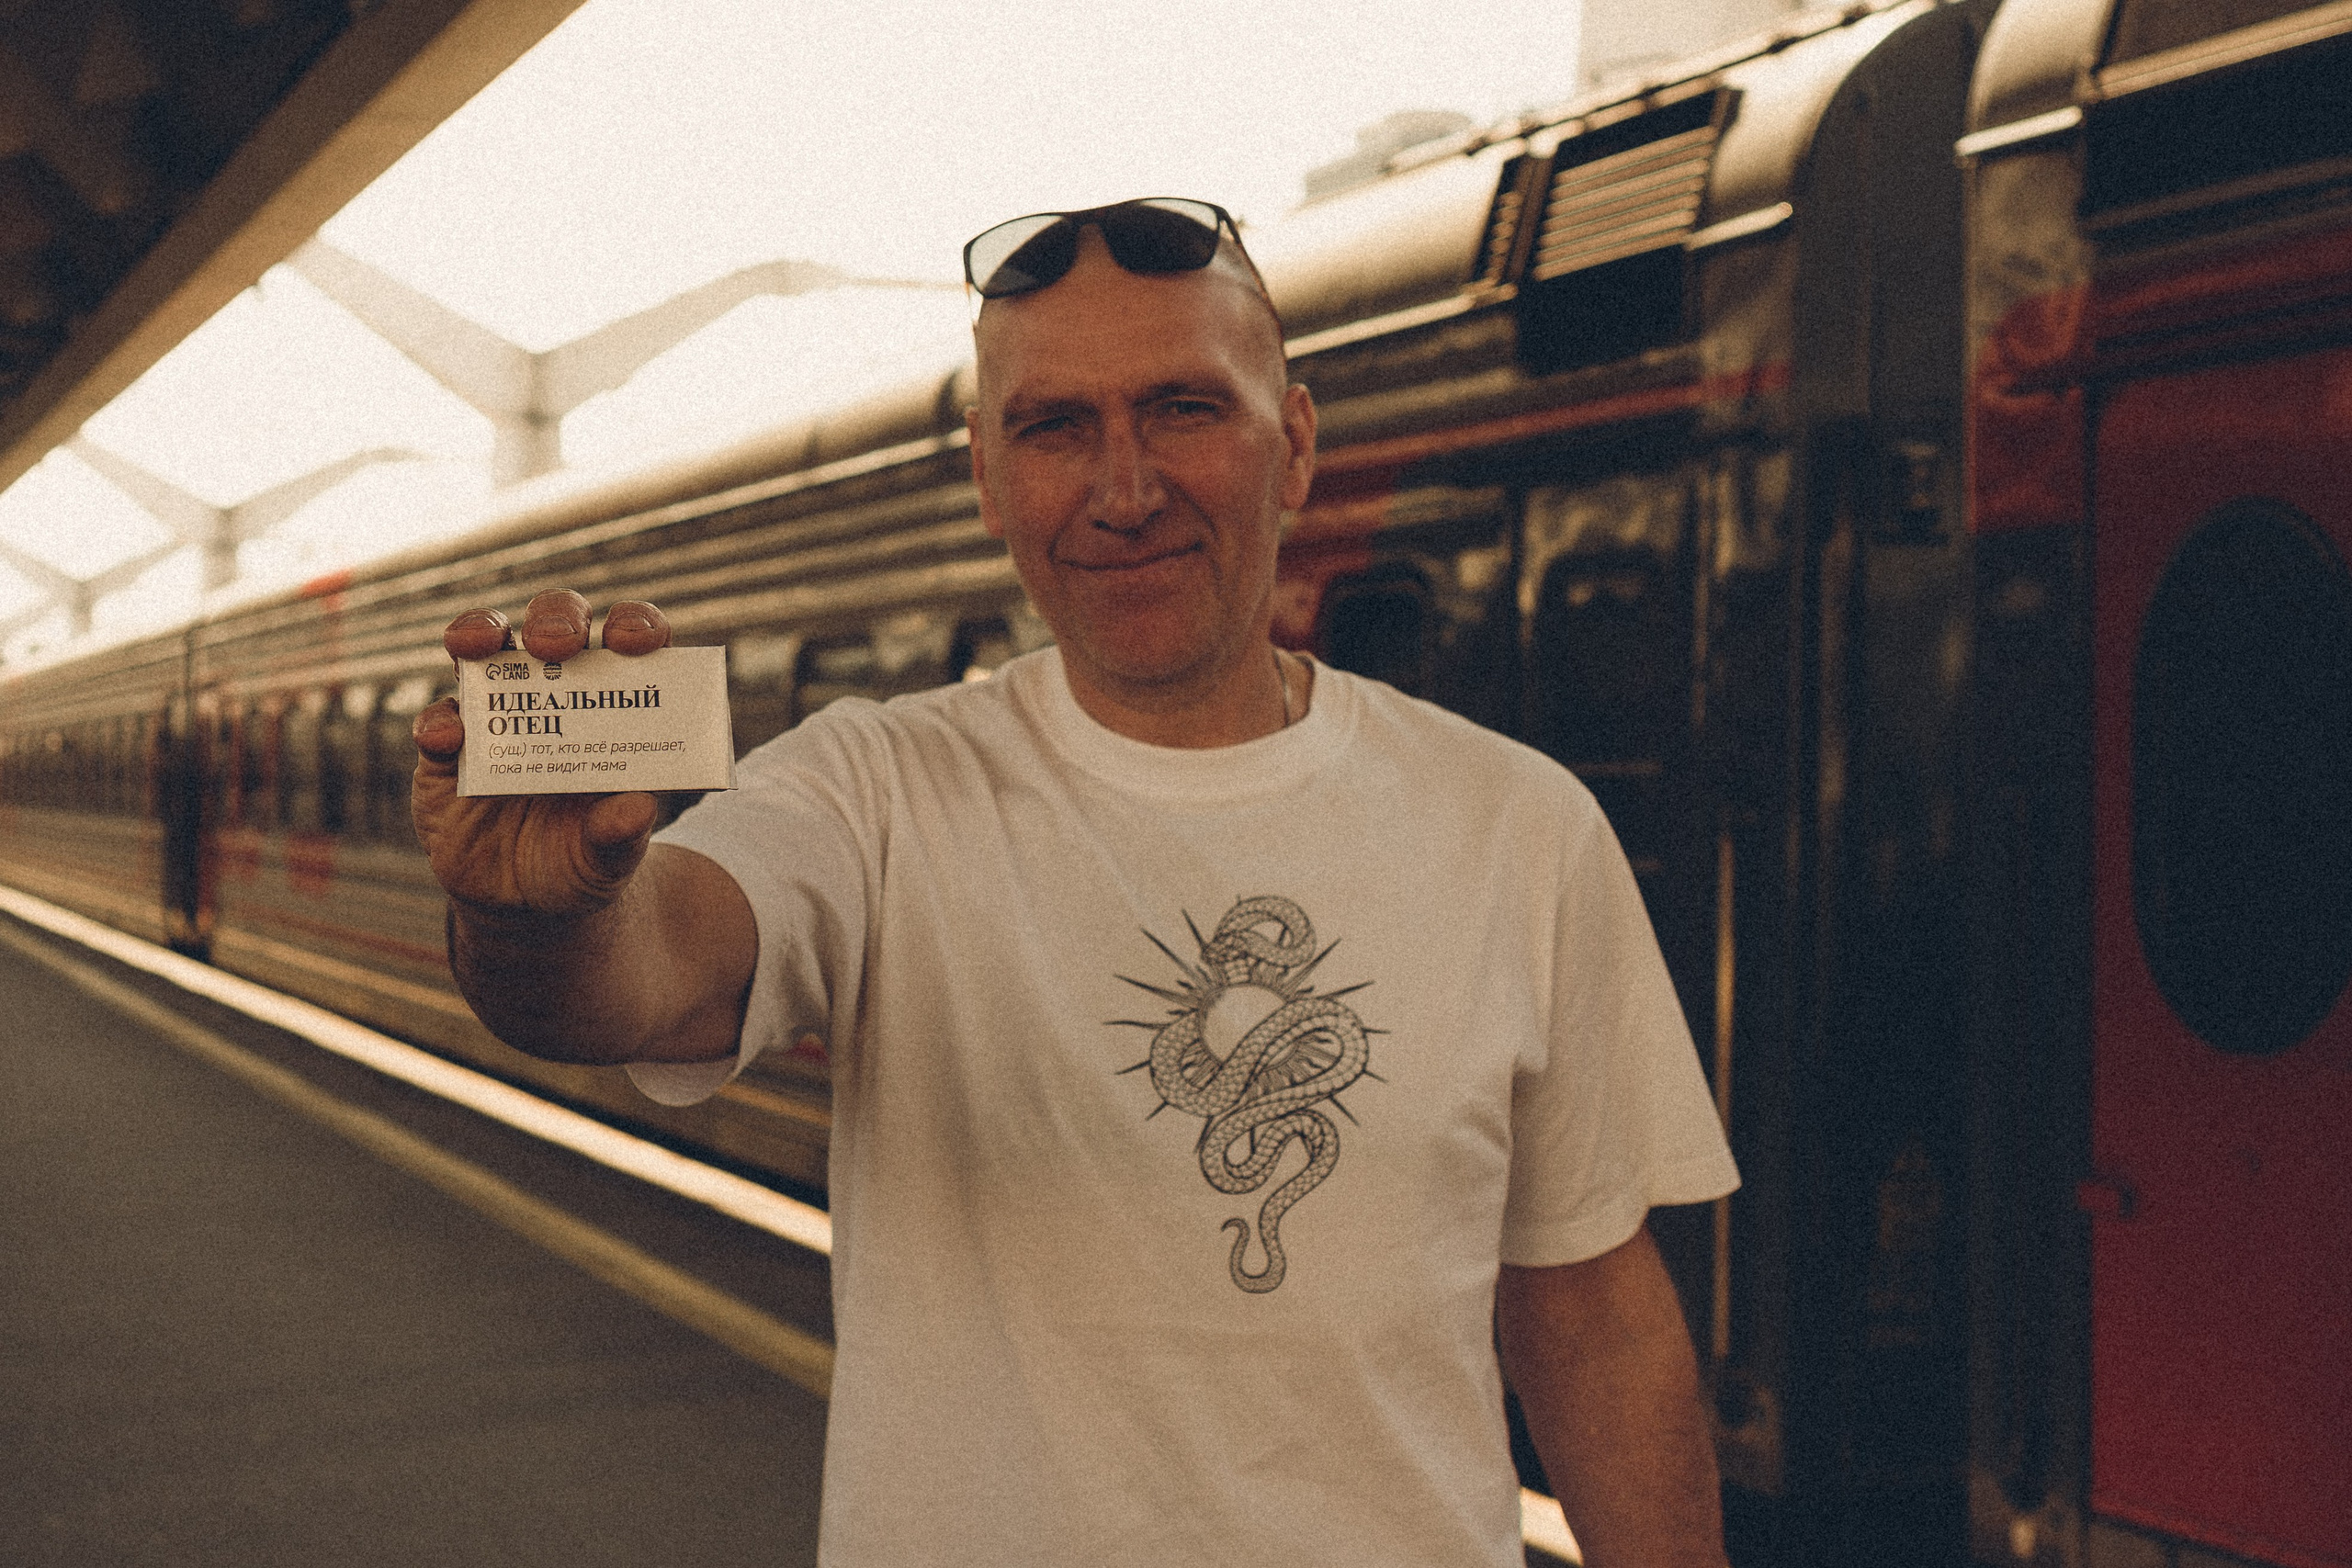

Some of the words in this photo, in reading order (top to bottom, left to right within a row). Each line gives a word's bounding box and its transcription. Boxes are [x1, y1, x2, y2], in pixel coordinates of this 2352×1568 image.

[503, 662, 529, 671] SIMA
[503, 671, 530, 680] LAND
[487, 684, 662, 715] ИДЕАЛЬНЫЙ
[488, 715, 563, 739] ОТЕЦ
[489, 742, 526, 758] (сущ.)
[530, 744, 554, 756] тот,
[558, 743, 581, 754] кто
[583, 740, 607, 753] всё
[610, 740, 686, 755] разрешает,
[489, 763, 522, 774] пока
[526, 762, 543, 773] не
[547, 761, 588, 773] видит
[591, 761, 627, 771] мама
